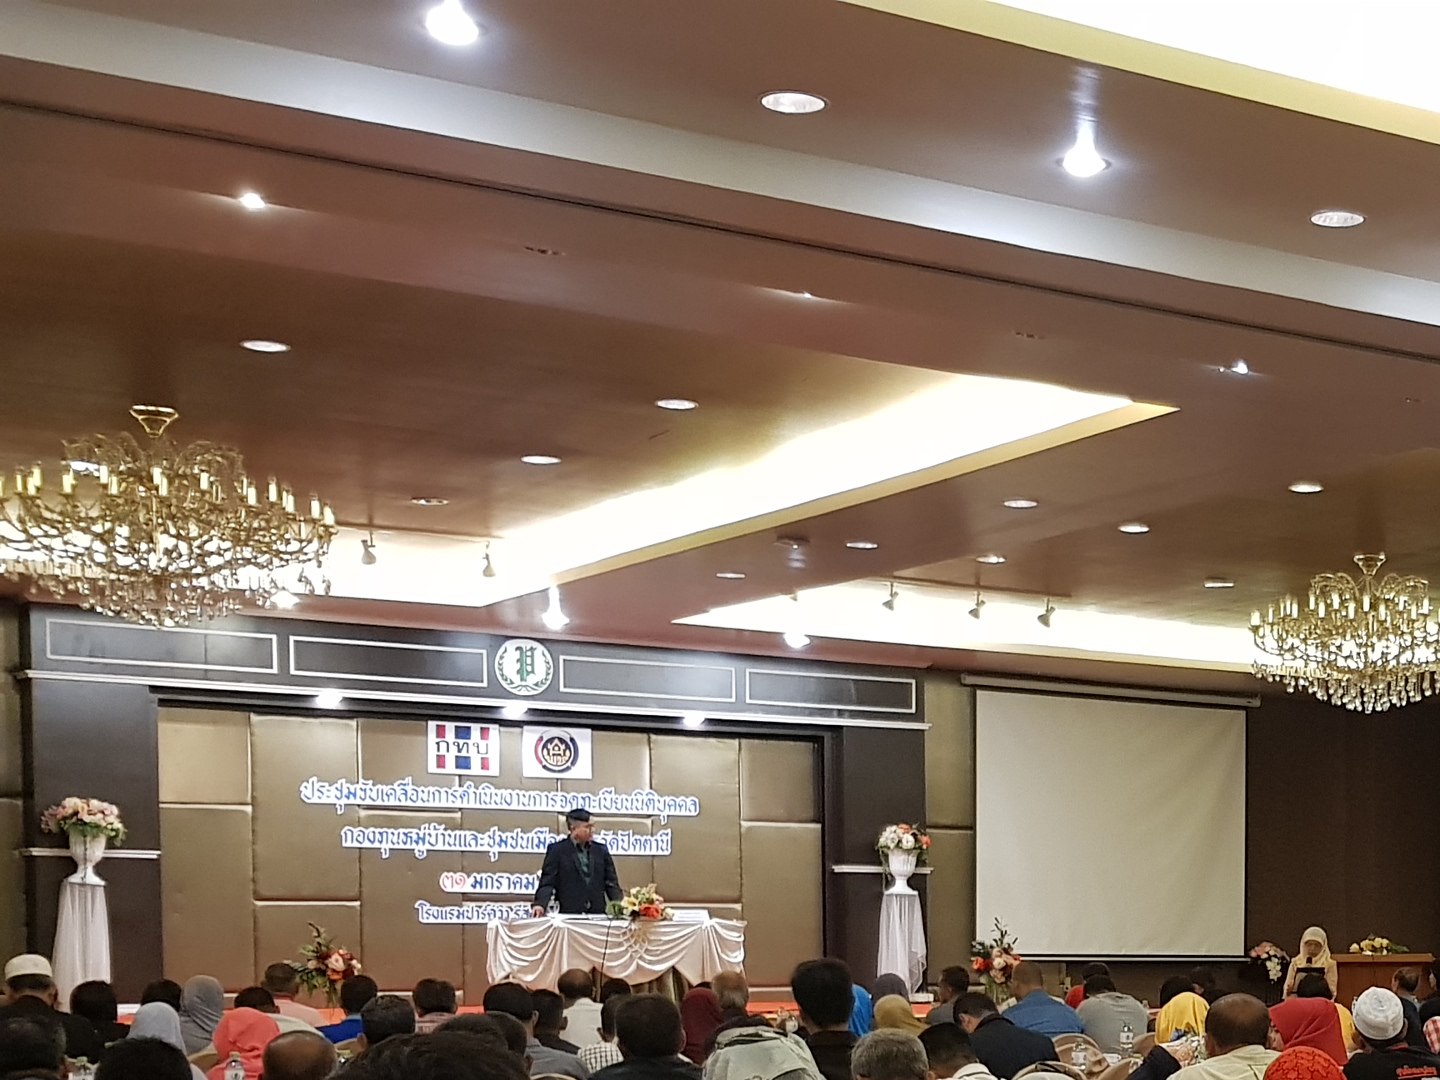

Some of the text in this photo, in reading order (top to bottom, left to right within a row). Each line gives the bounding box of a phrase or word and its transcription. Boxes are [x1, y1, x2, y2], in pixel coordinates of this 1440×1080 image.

[435, 740, 489, 755] กทบ
[471, 873, 535, 892] มกราคม
